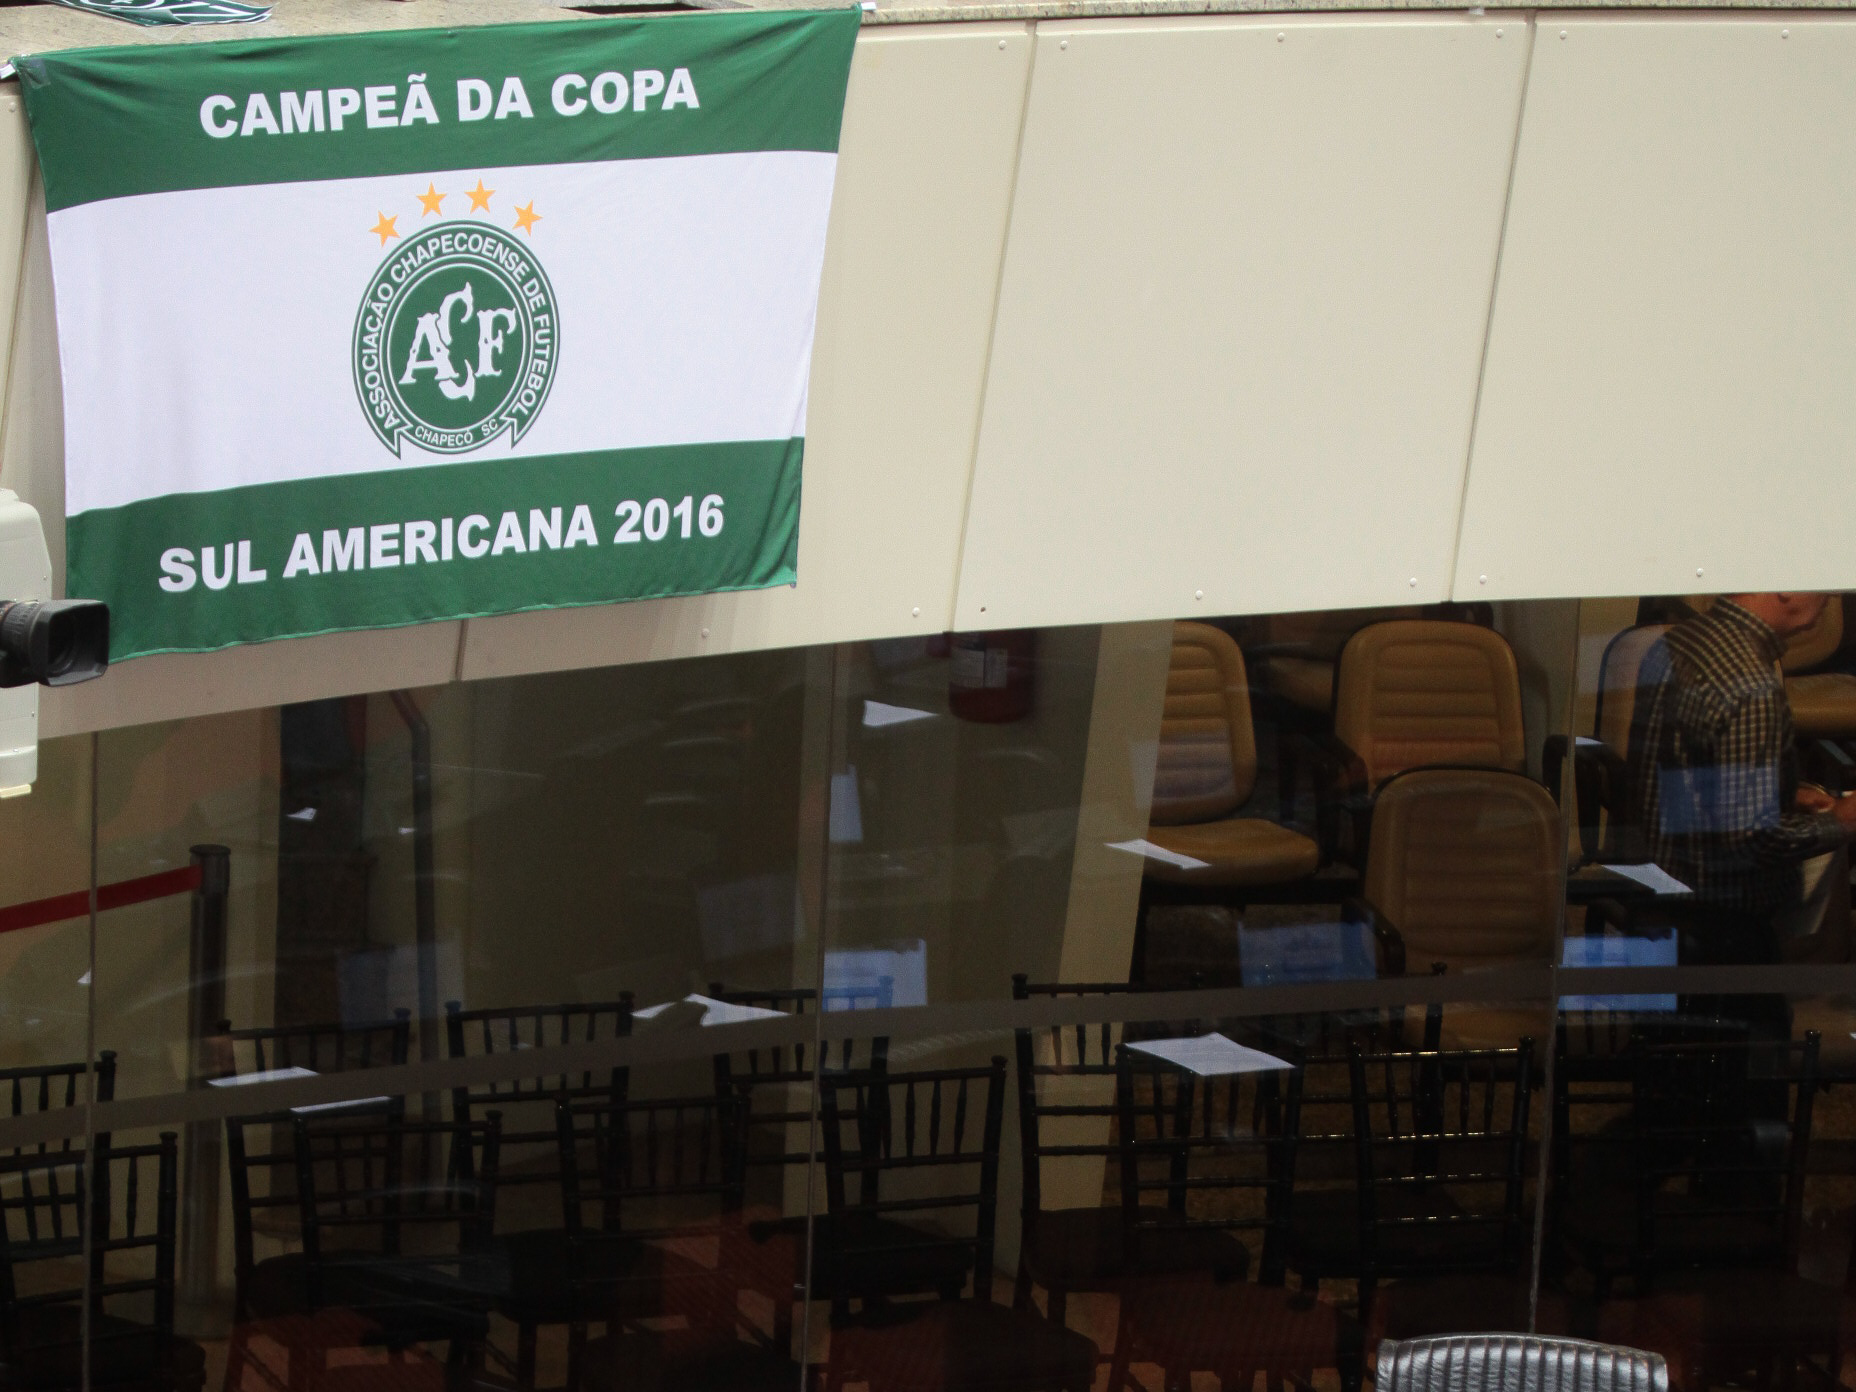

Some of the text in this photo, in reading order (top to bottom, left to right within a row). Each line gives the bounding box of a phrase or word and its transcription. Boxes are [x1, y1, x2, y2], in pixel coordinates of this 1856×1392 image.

[199, 67, 700, 139] CAMPEÃ DA COPA
[362, 232, 550, 430] ASSOCIAÇÃO CHAPECOENSE DE FUTEBOL
[481, 418, 499, 438] SC
[158, 494, 725, 592] SUL AMERICANA 2016
